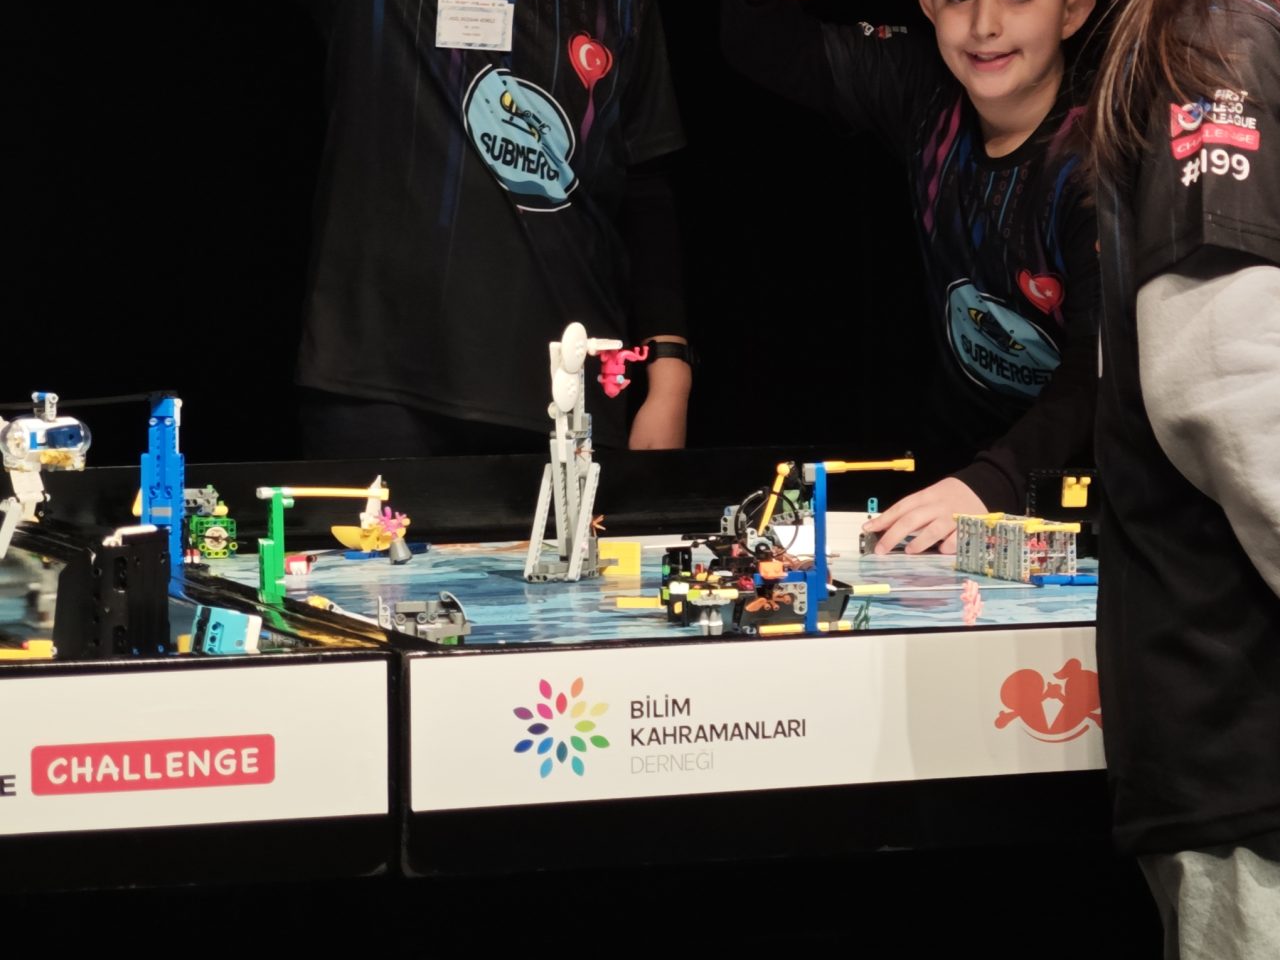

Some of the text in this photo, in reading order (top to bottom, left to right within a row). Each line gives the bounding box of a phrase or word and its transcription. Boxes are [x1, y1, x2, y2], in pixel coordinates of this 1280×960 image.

[1212, 112, 1257, 130] LEAGUE
[480, 132, 560, 182] SUBMERG
[1181, 148, 1250, 187] #199
[630, 694, 691, 719] BİLİM
[630, 718, 807, 747] KAHRAMANLARI
[47, 747, 260, 785] CHALLENGE
